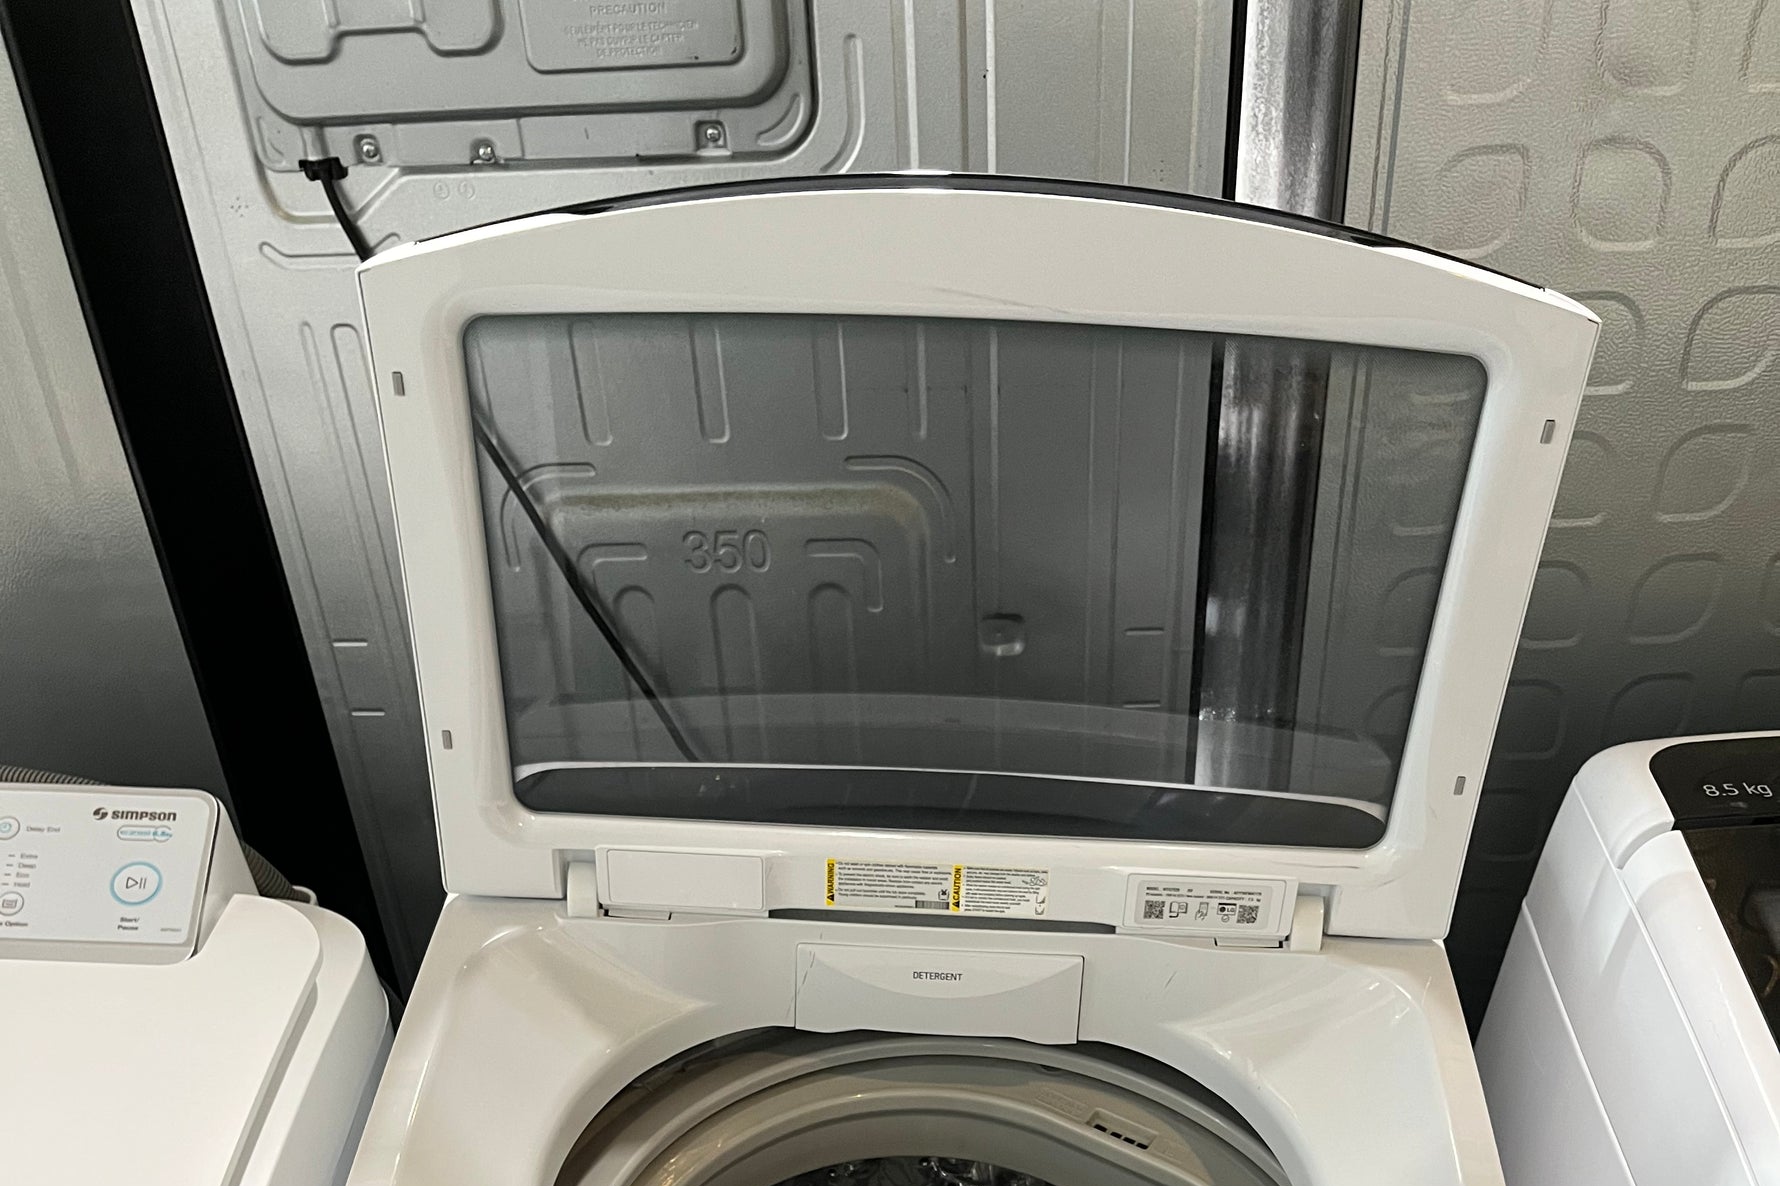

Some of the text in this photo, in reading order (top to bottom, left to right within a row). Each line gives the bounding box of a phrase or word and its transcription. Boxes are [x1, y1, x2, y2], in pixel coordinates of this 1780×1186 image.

[682, 529, 771, 573] 350
[1703, 782, 1773, 797] 8.5 kg
[111, 810, 177, 822] SIMPSON
[953, 867, 962, 900] CAUTION
[913, 971, 963, 981] DETERGENT
